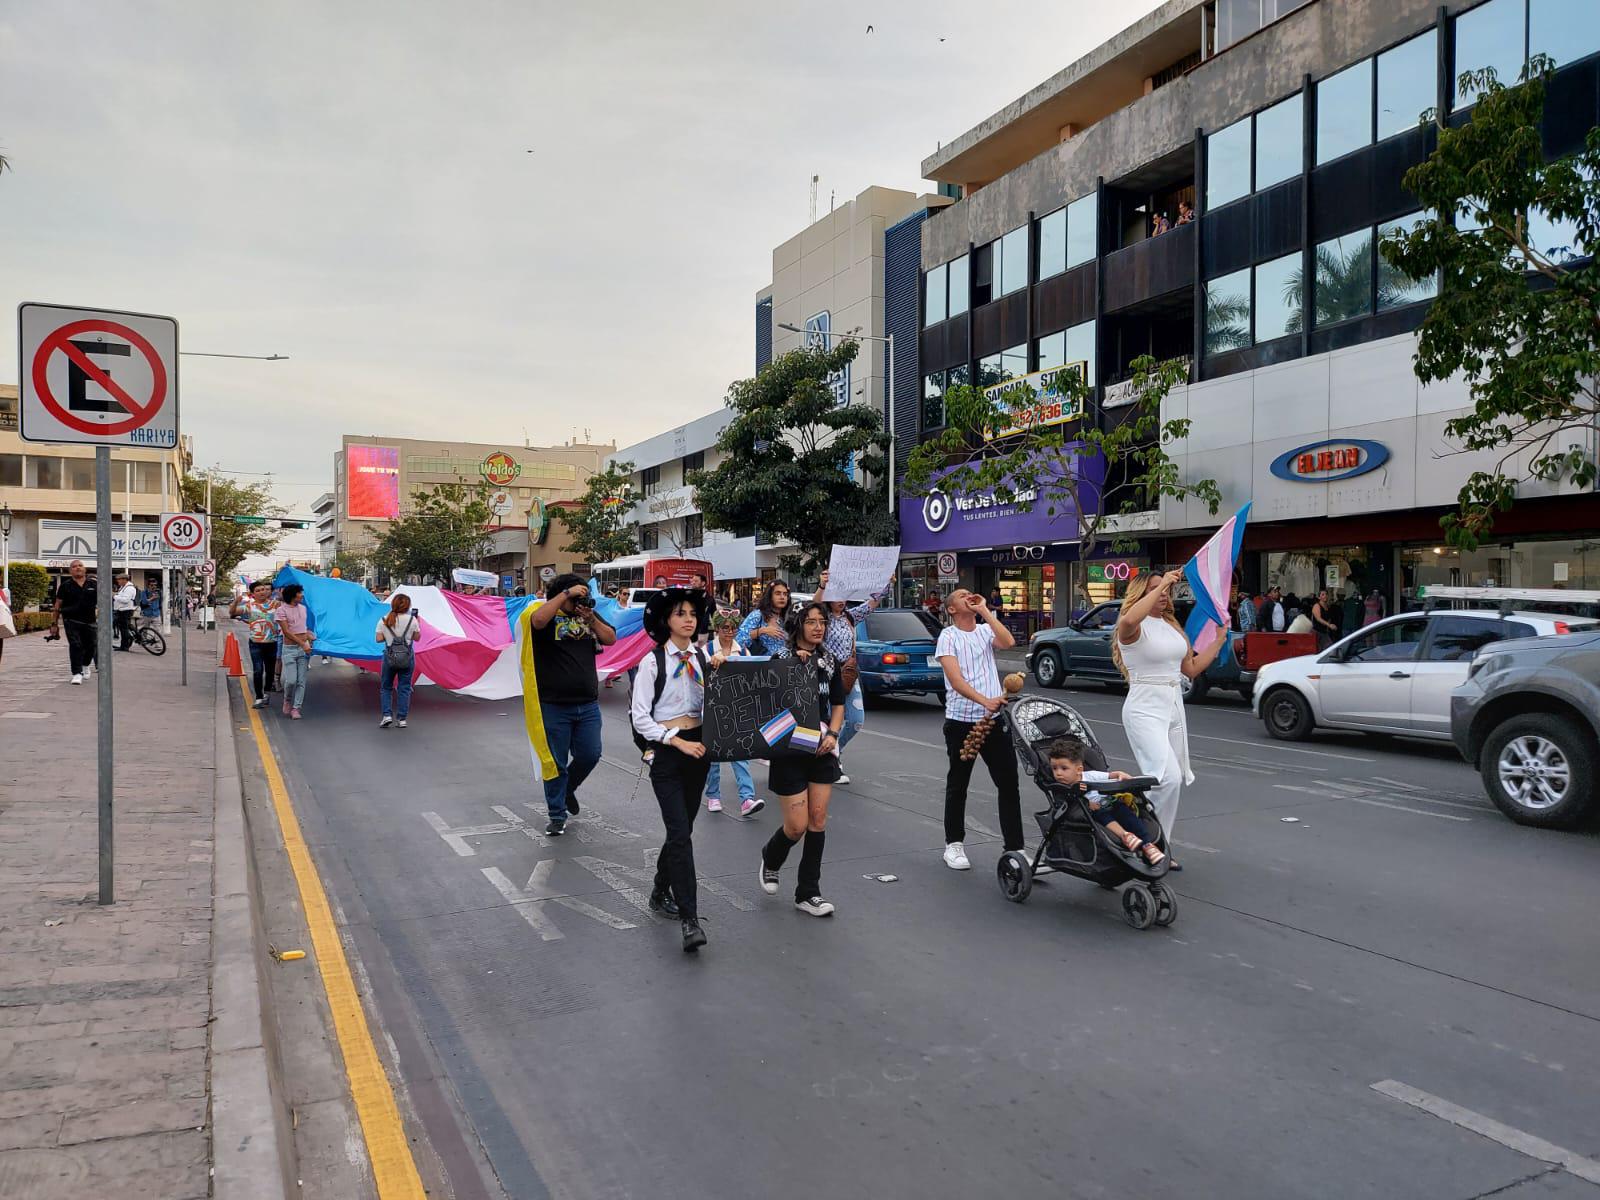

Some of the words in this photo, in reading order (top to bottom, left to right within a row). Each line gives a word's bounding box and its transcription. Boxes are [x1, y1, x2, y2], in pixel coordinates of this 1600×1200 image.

[1297, 453, 1315, 473] EL
[1317, 447, 1360, 471] JEAN
[480, 463, 521, 476] Waldo's
[955, 497, 974, 511] Ver
[172, 522, 193, 537] 30
[111, 533, 161, 555] onchi
